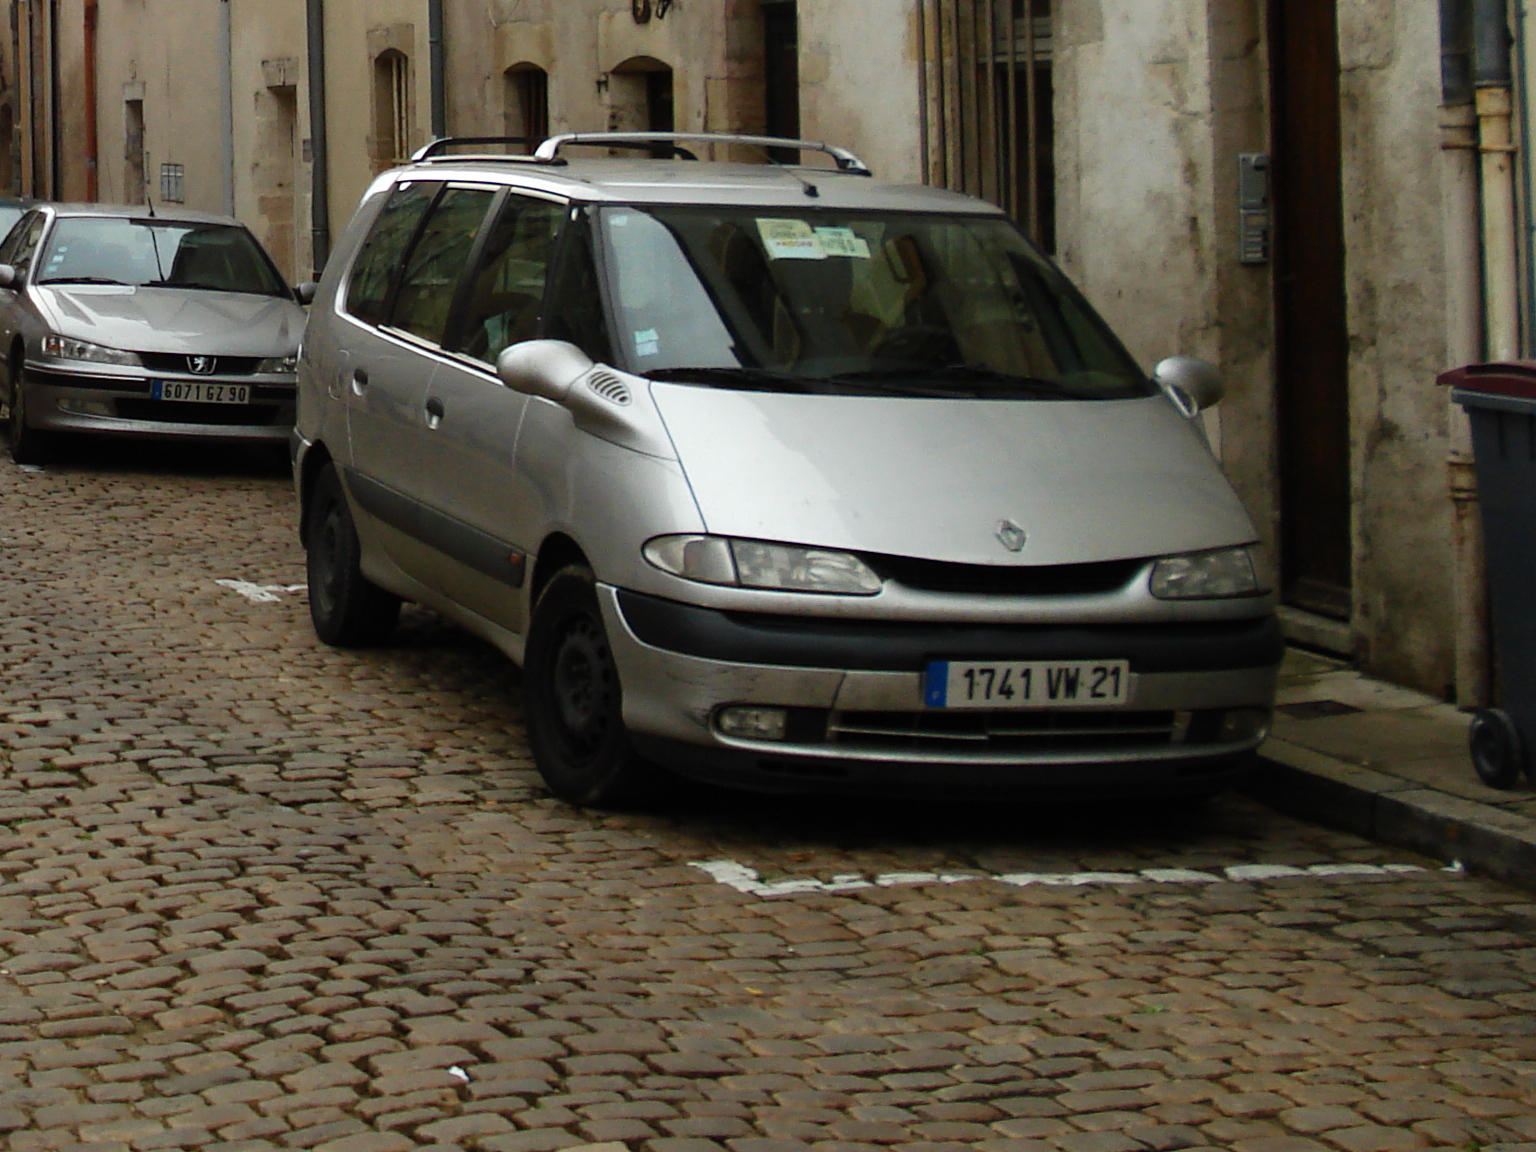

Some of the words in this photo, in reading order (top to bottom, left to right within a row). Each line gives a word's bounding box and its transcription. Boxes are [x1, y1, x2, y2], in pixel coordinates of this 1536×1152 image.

[165, 384, 200, 400] 6071
[206, 386, 223, 401] GZ
[229, 387, 246, 402] 90
[963, 667, 1032, 701] 1741
[1046, 667, 1081, 700] VW
[1090, 665, 1121, 699] 21
